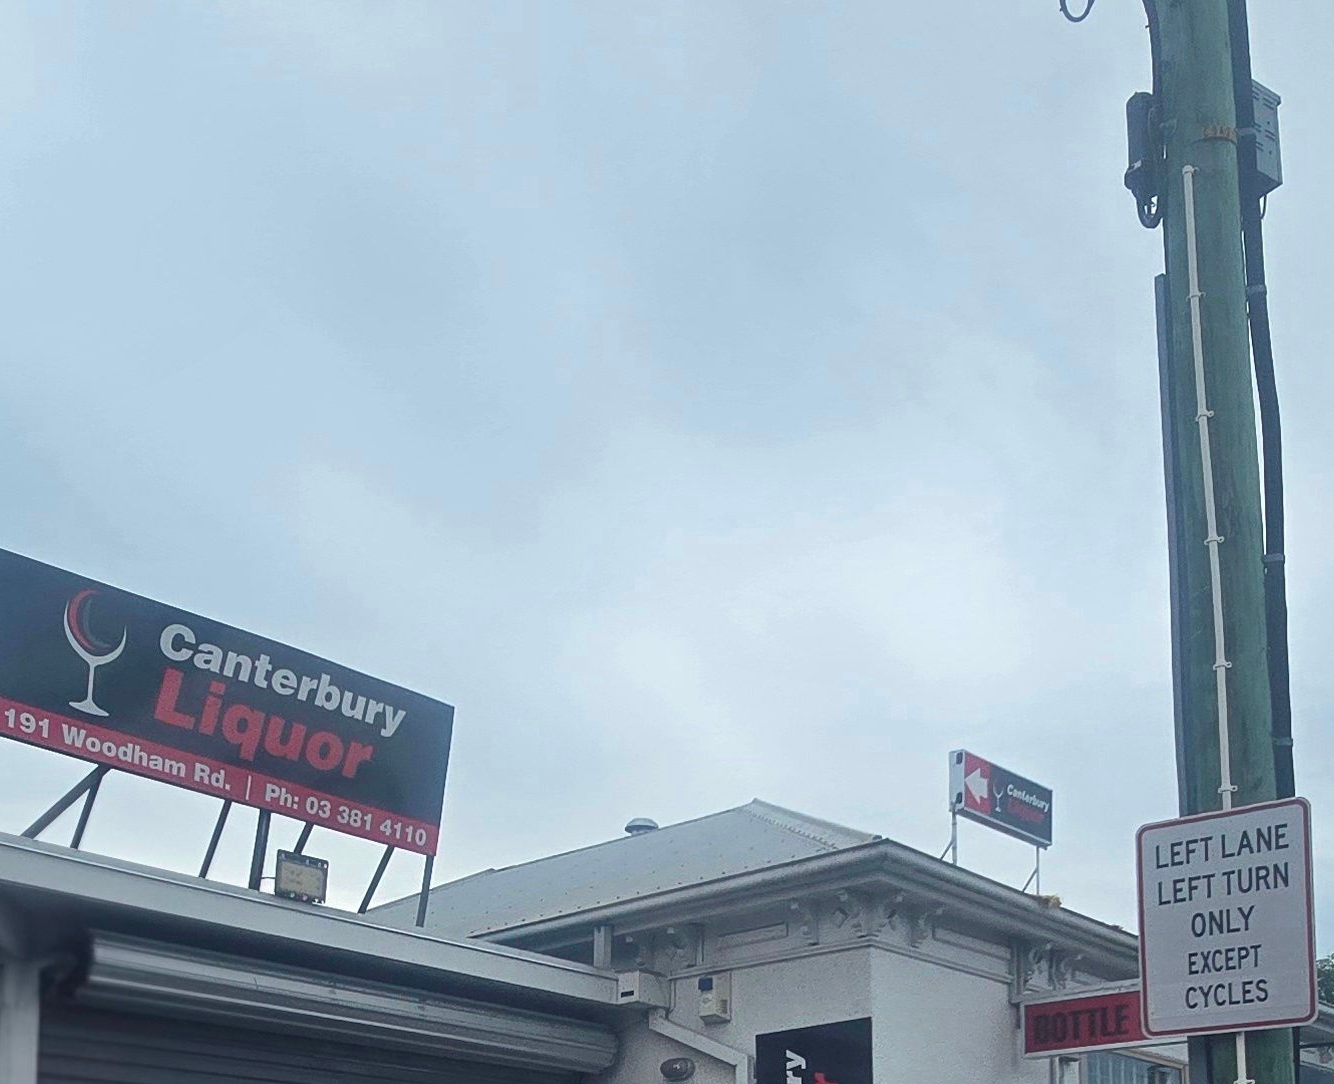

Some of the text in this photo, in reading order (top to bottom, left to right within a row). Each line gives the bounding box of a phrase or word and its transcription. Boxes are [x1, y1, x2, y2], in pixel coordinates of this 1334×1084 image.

[159, 623, 407, 738] Canterbury
[154, 668, 375, 779] Liquor
[4, 708, 427, 847] 191 Woodham Rd. Ph: 03 381 4110
[1007, 784, 1049, 812] Canterbury
[1155, 823, 1290, 869] LEFT LANE
[1158, 862, 1289, 906] LEFT TURN
[1191, 905, 1255, 938] ONLY
[1188, 944, 1262, 975] EXCEPT
[1185, 979, 1269, 1009] CYCLES
[1034, 1004, 1129, 1044] BOTTLE
